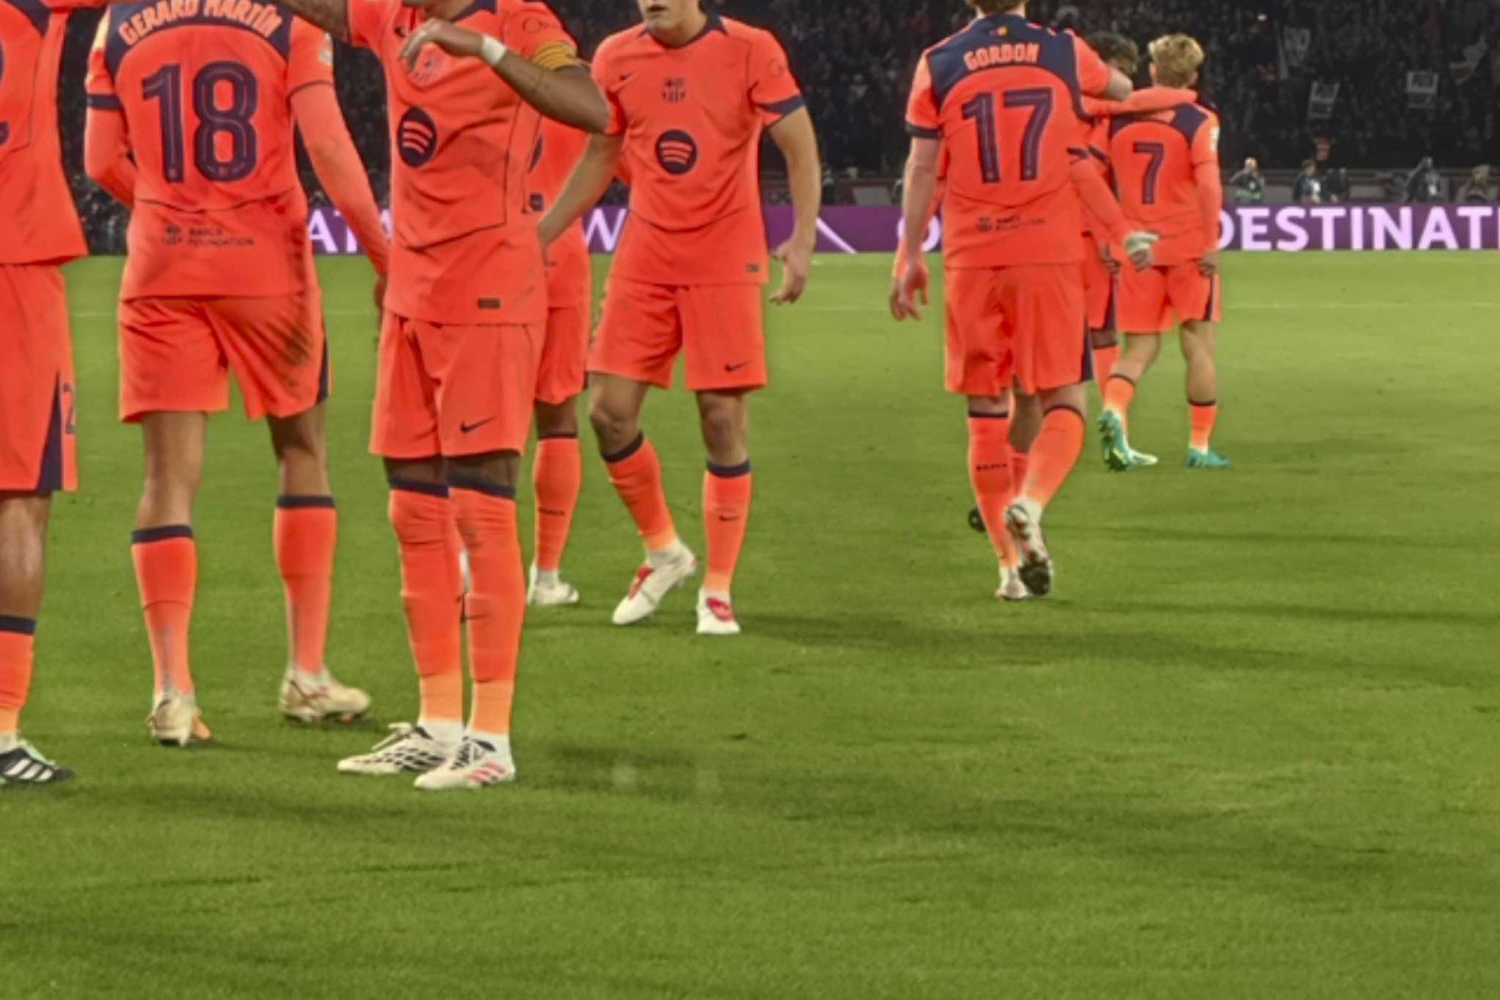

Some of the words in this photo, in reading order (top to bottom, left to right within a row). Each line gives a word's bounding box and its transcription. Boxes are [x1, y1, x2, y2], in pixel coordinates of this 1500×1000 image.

[963, 42, 1040, 71] GORDON
[142, 60, 257, 184] 18
[961, 86, 1054, 184] 17
[1132, 141, 1164, 205] 7
[1218, 206, 1500, 251] ESTINAT
